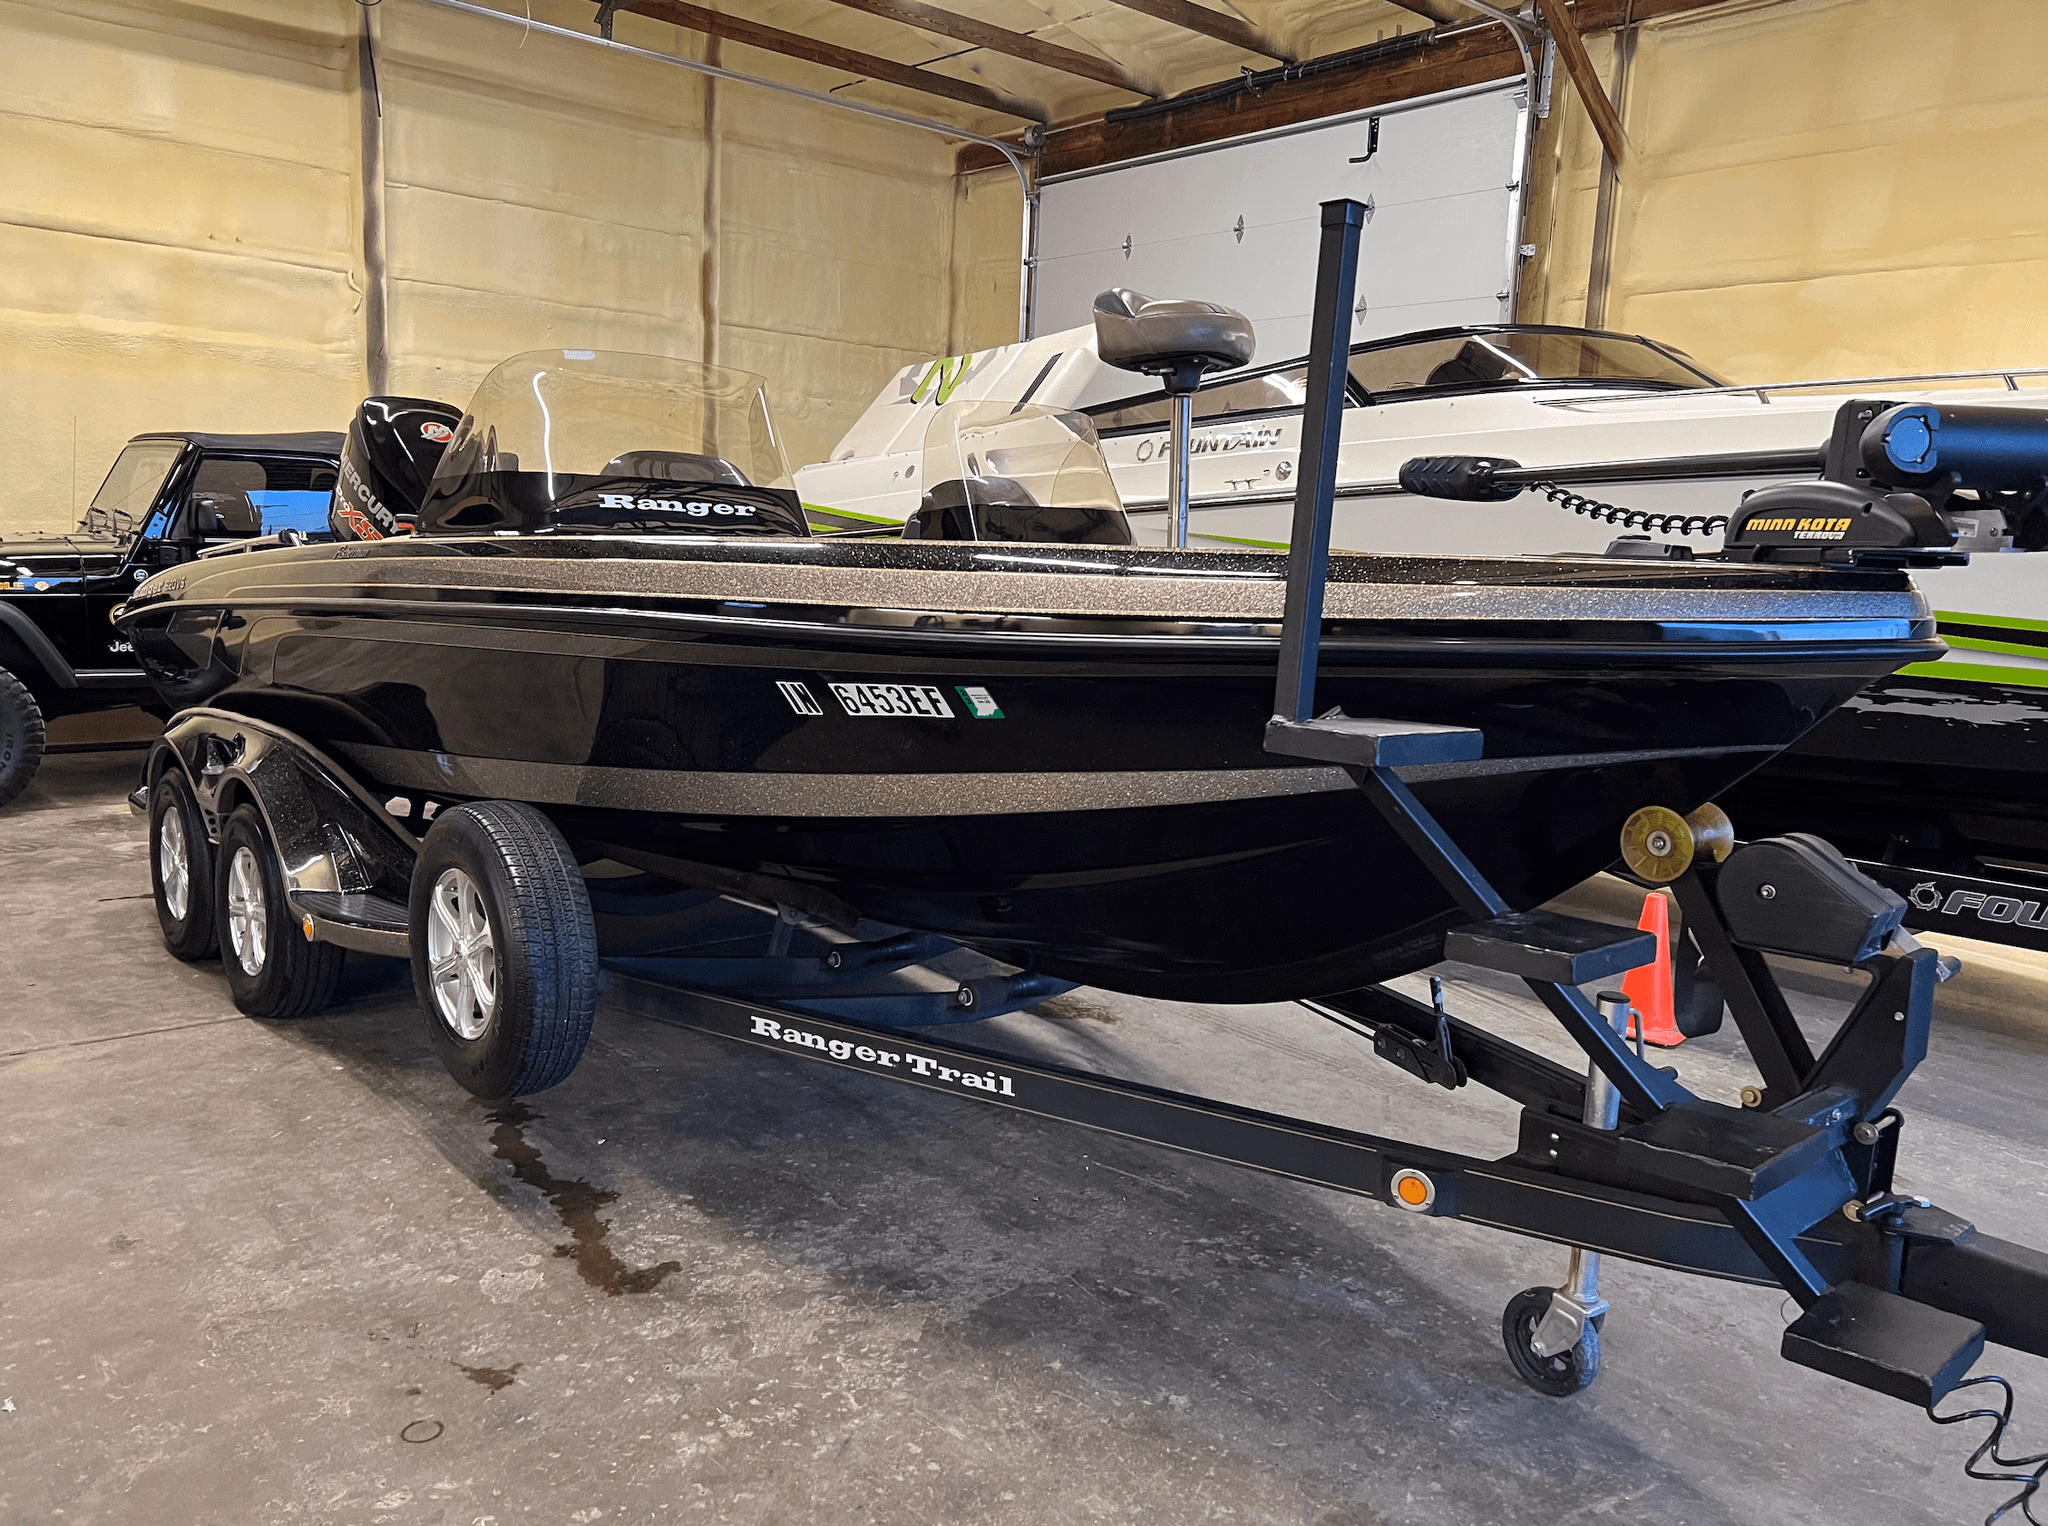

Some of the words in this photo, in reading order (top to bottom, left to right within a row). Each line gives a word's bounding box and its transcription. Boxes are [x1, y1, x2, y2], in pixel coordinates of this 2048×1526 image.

[1158, 428, 1282, 458] FUNTAIN
[598, 493, 757, 517] Ranger
[1796, 518, 1852, 531] KOTA
[108, 640, 135, 653] Jee
[778, 683, 822, 714] IN
[831, 684, 950, 716] 6453EF
[750, 1015, 900, 1068] Ranger
[905, 1053, 1016, 1097] Trail
